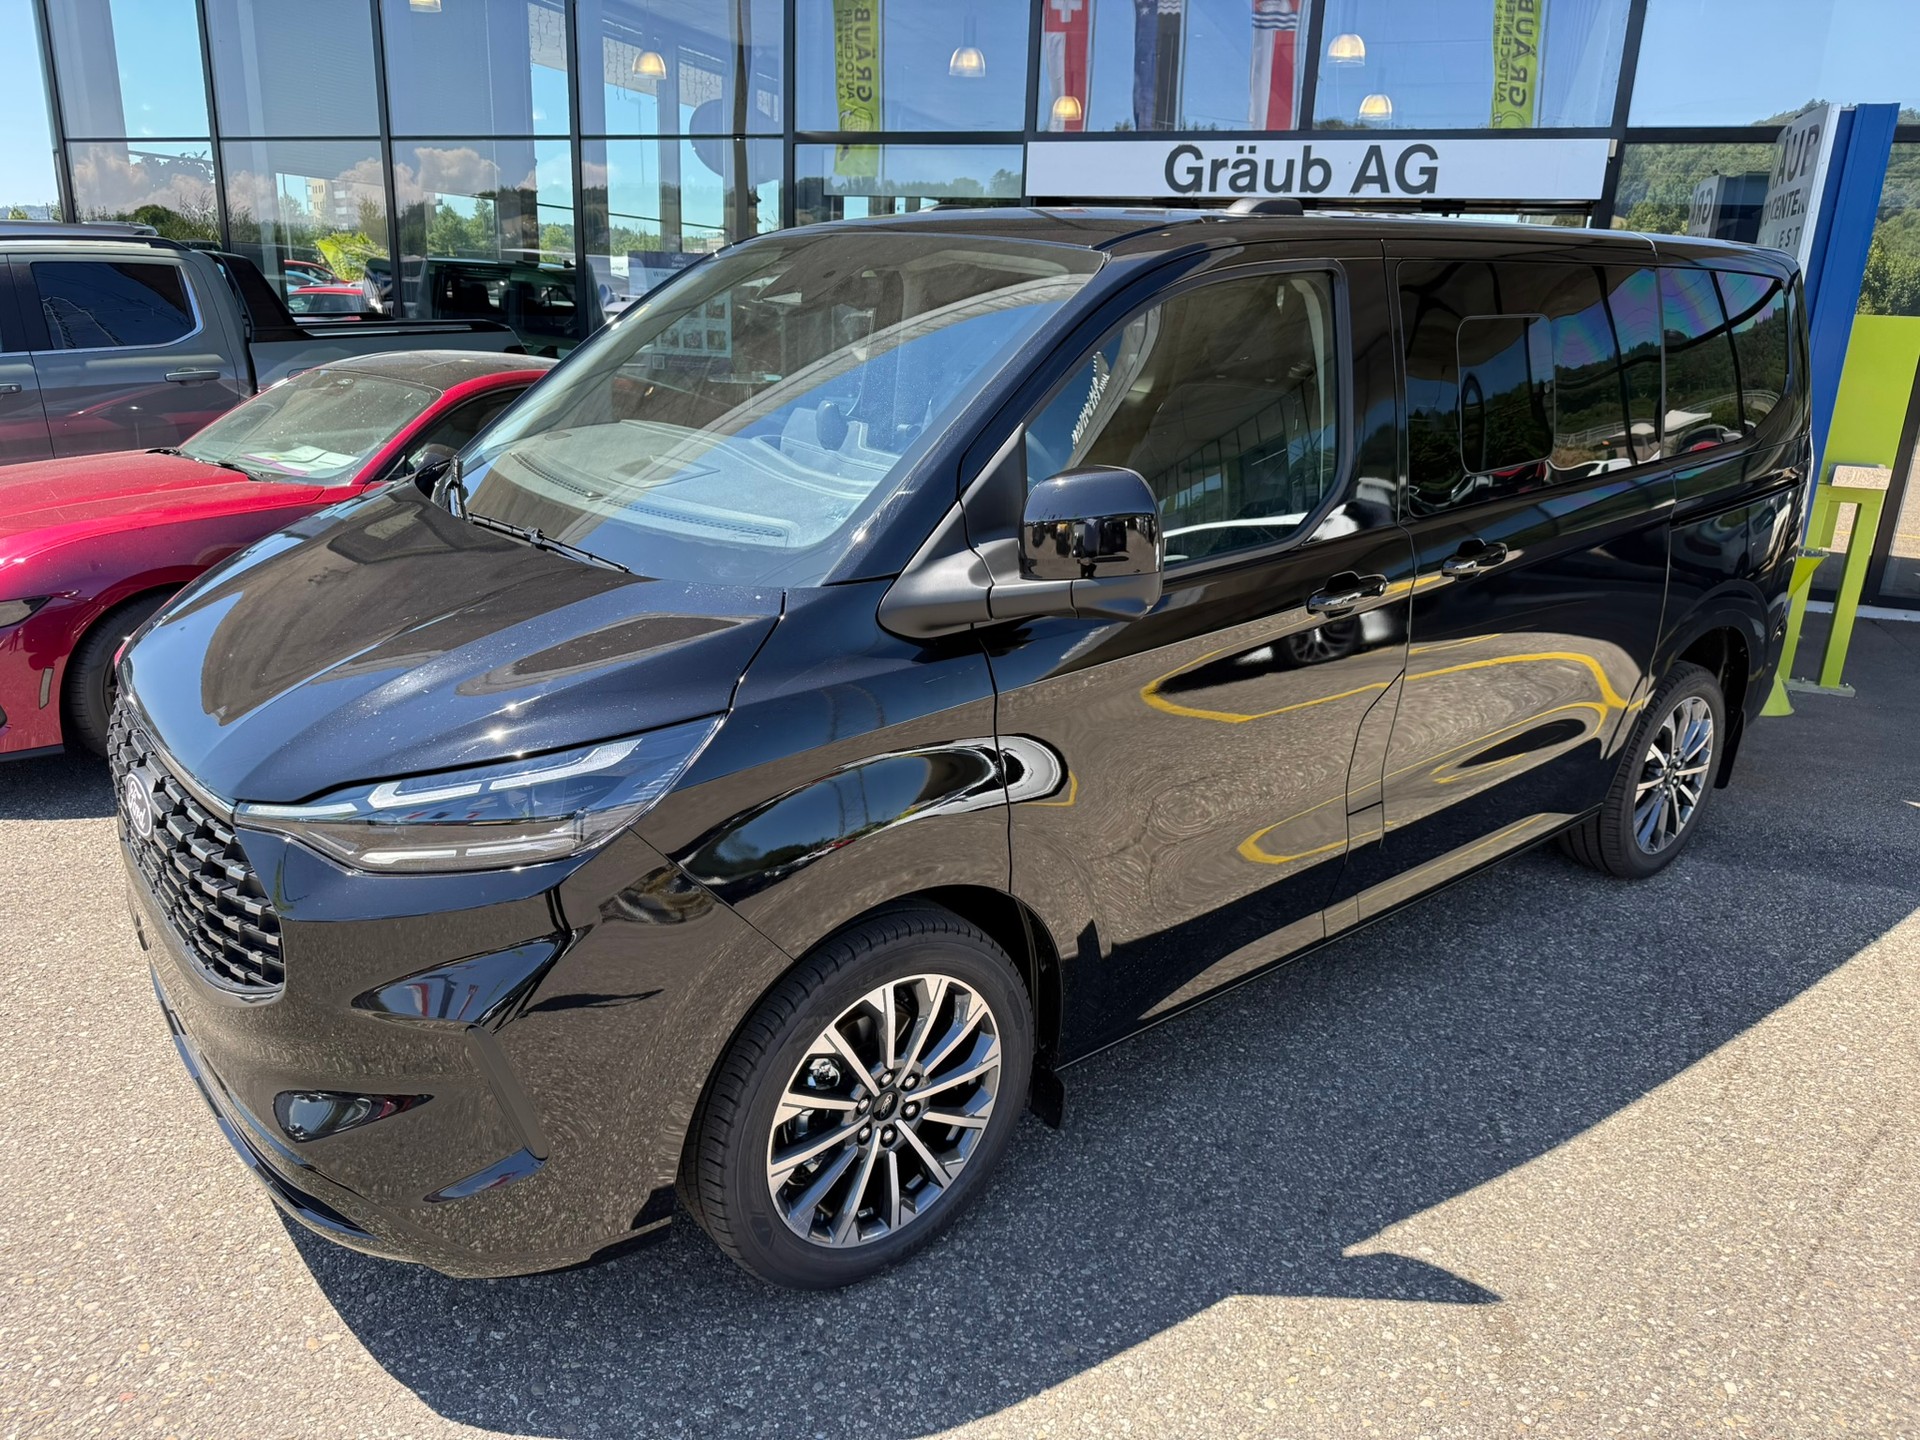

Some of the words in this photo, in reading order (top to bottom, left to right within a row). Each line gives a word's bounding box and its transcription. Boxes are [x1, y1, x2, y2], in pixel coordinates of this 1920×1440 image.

[1165, 144, 1332, 194] Gräub
[1350, 144, 1439, 195] AG
[128, 778, 148, 831] Ford
